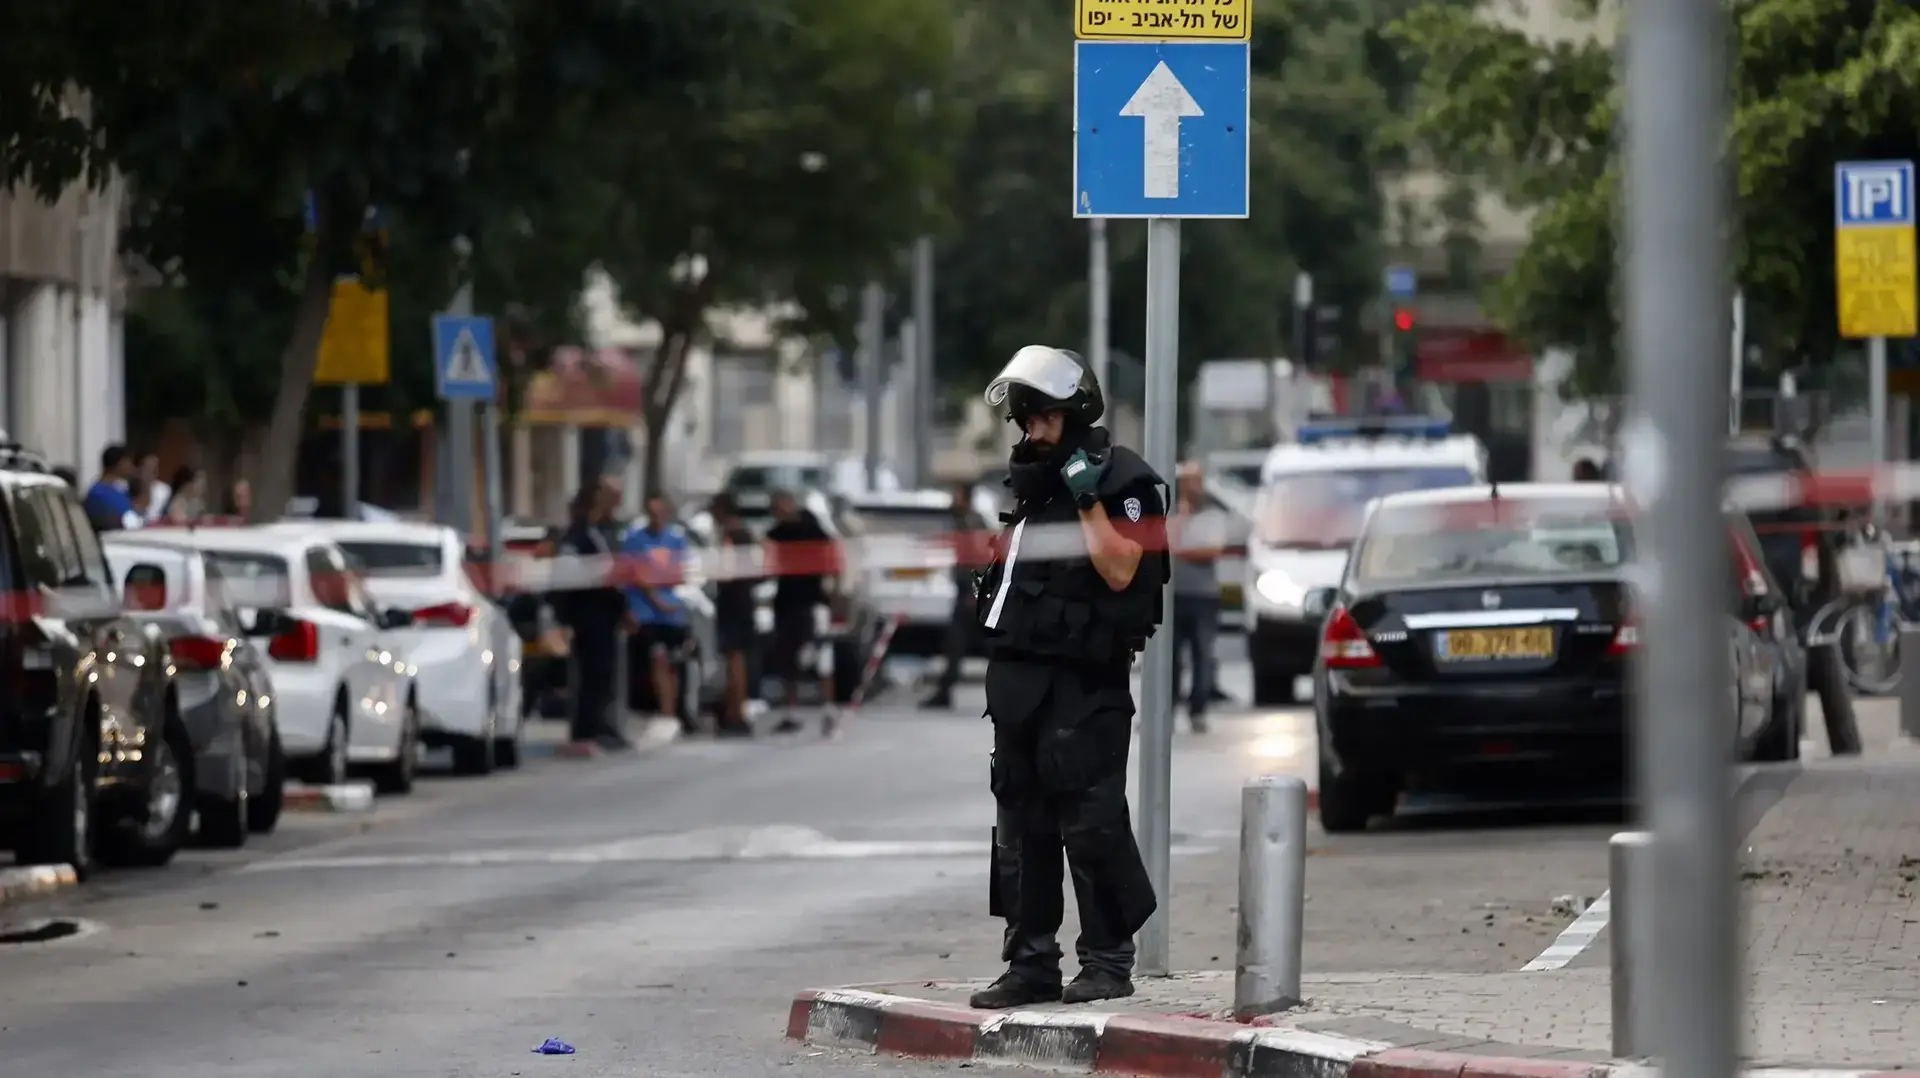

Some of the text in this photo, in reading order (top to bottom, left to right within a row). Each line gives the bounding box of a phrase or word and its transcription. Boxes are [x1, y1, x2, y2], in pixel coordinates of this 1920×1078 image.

[1088, 11, 1112, 26] יפו
[1132, 9, 1204, 28] תל-אביב
[1211, 10, 1239, 29] של
